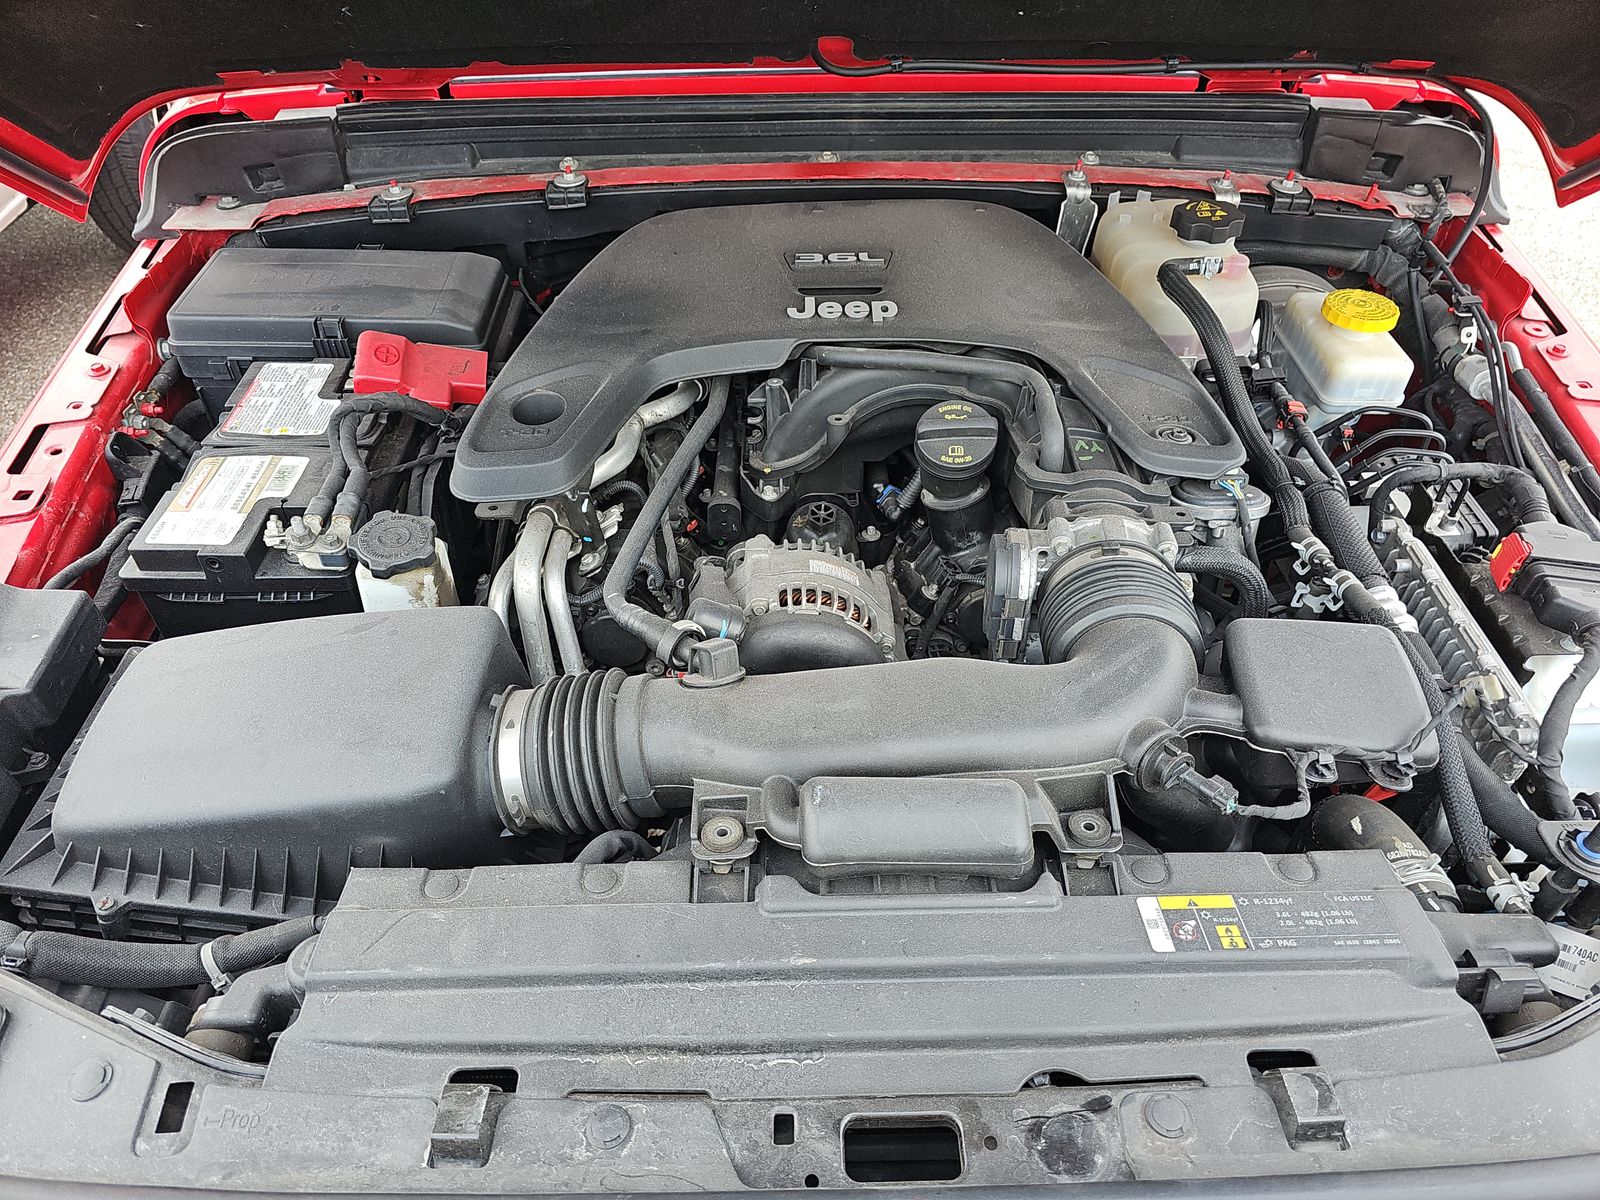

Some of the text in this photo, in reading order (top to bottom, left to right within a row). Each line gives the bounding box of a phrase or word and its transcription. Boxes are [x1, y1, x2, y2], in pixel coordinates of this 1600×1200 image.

[794, 252, 885, 265] 3.6L
[786, 296, 899, 322] Jeep
[938, 404, 973, 413] ENGINE OIL
[940, 455, 953, 463] SAE
[1252, 897, 1293, 906] R-1234yf
[1276, 939, 1298, 947] PAG
[1571, 945, 1599, 963] 740AC
[220, 1108, 261, 1132] Prop
